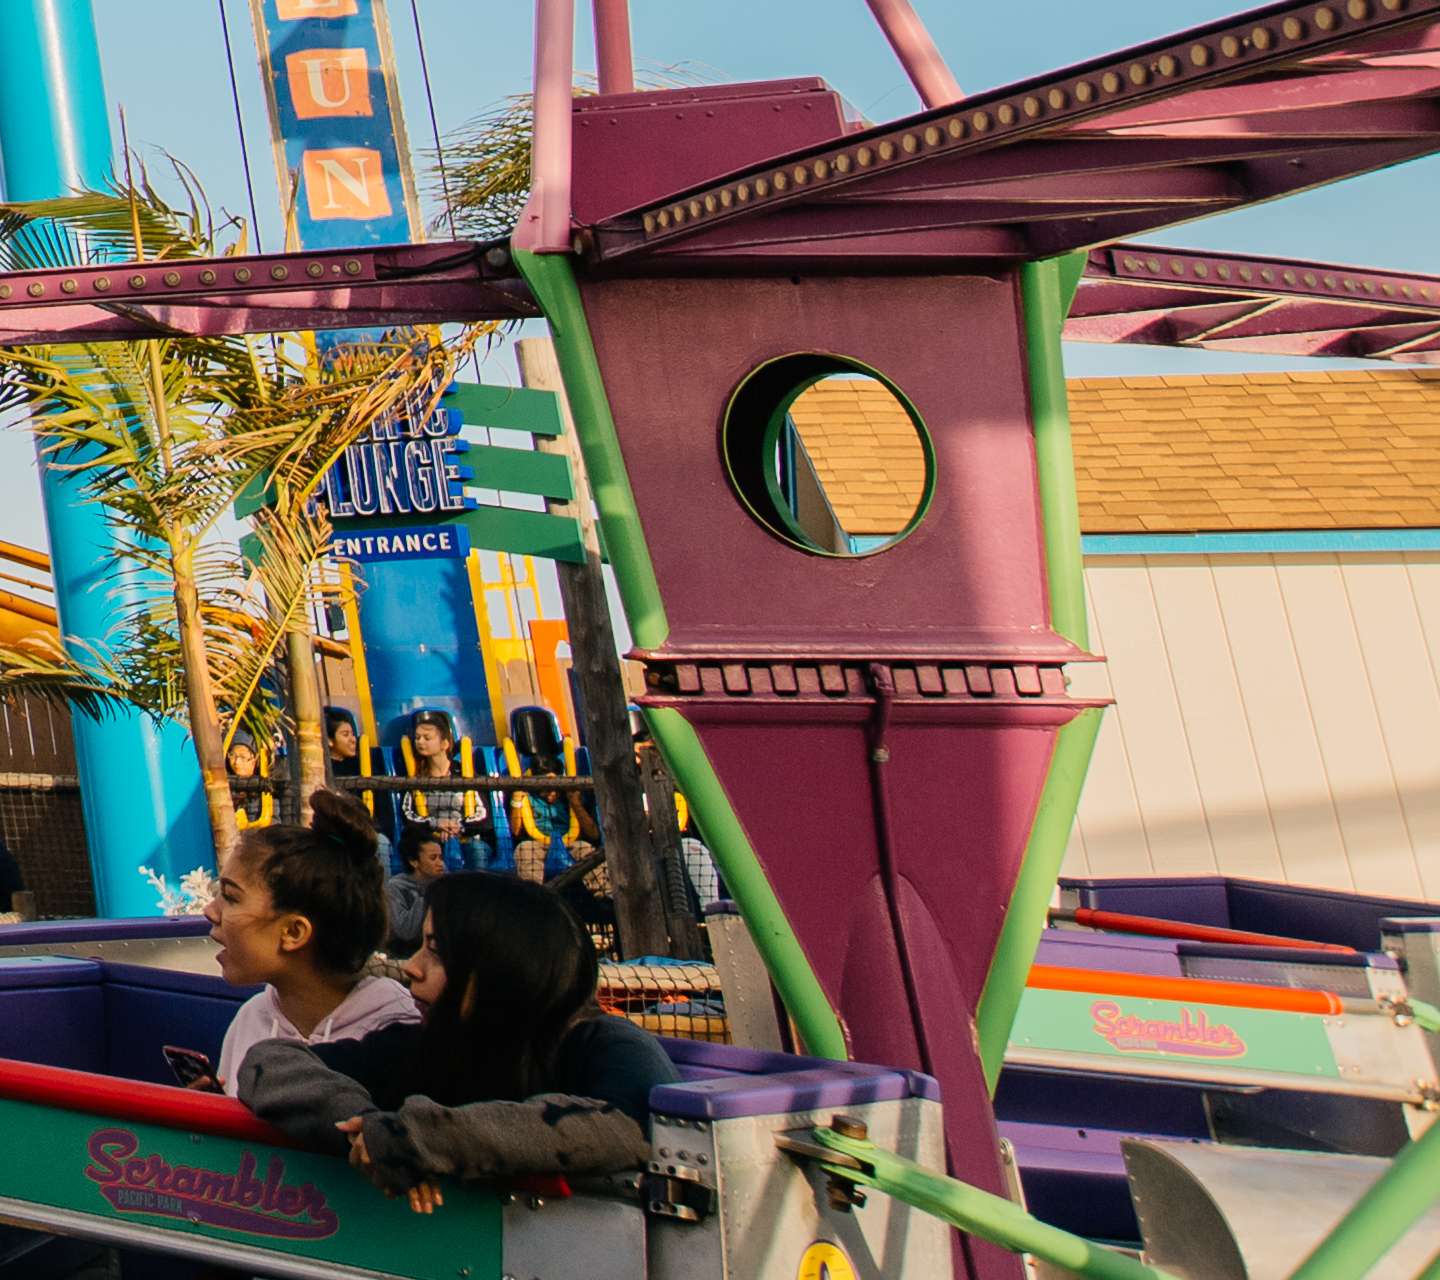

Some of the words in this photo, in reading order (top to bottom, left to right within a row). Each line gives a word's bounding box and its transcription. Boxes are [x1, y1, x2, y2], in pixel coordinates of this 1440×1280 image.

[334, 533, 452, 556] ENTRANCE
[1091, 1000, 1247, 1056] Scrambler
[84, 1128, 339, 1237] Scrambler
[118, 1190, 154, 1207] PACIFIC
[157, 1195, 183, 1214] PARK
